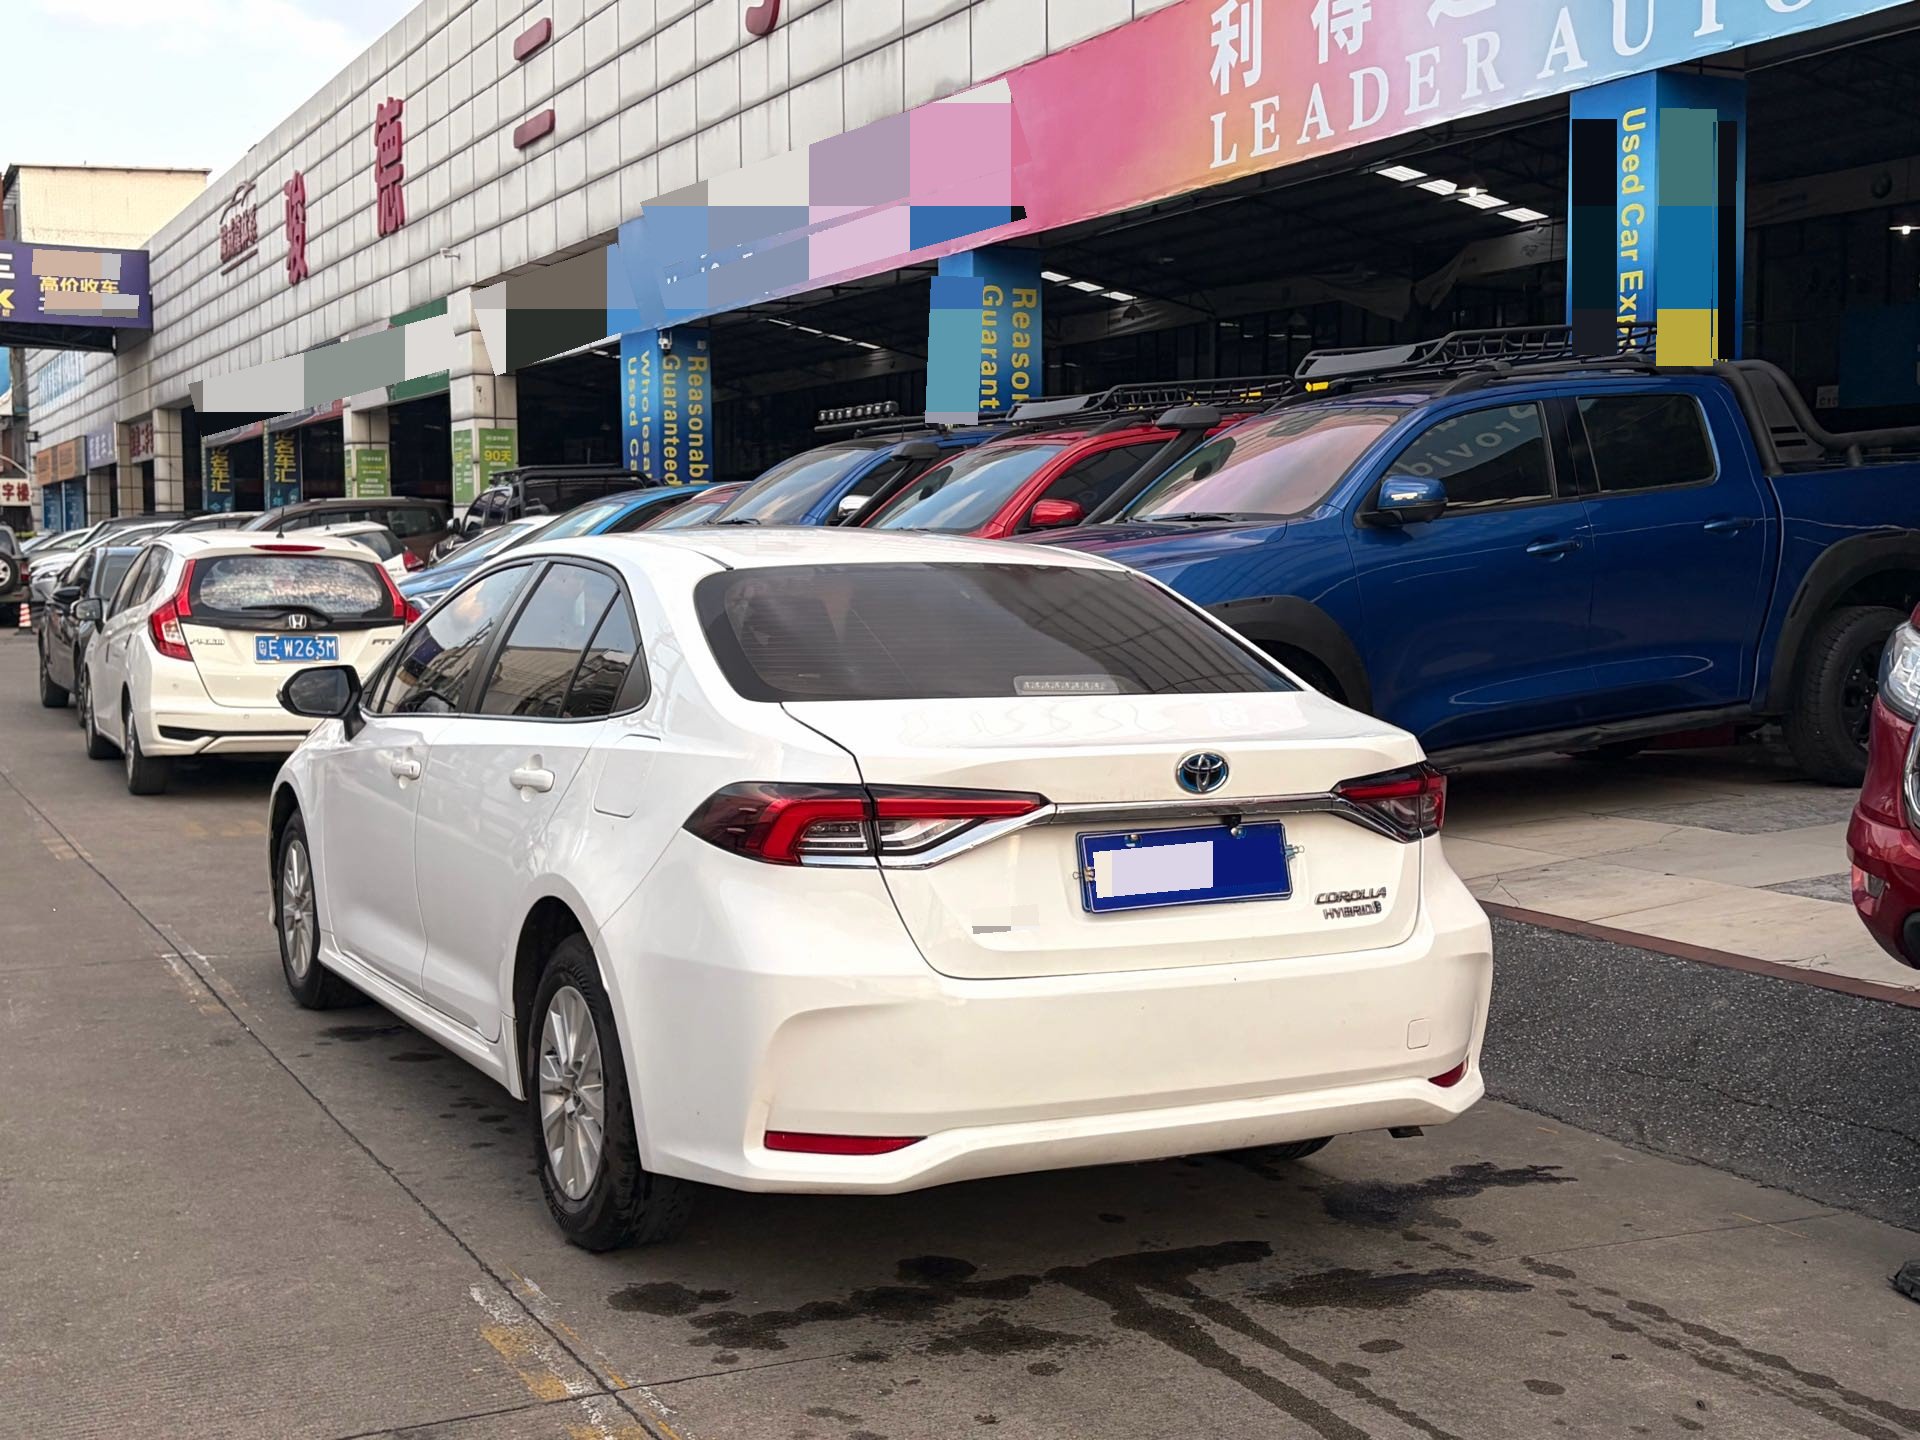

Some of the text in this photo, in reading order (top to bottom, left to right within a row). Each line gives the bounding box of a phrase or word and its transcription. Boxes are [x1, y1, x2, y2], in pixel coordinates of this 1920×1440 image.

[1209, 0, 1802, 169] LEADER AU
[1621, 107, 1647, 195] Used
[1620, 203, 1646, 262] Car
[628, 356, 639, 427] Used
[662, 354, 683, 487] Guaranteed
[484, 449, 512, 462] 90天
[1314, 886, 1387, 905] COROLLA
[1322, 903, 1375, 920] HYBRID
